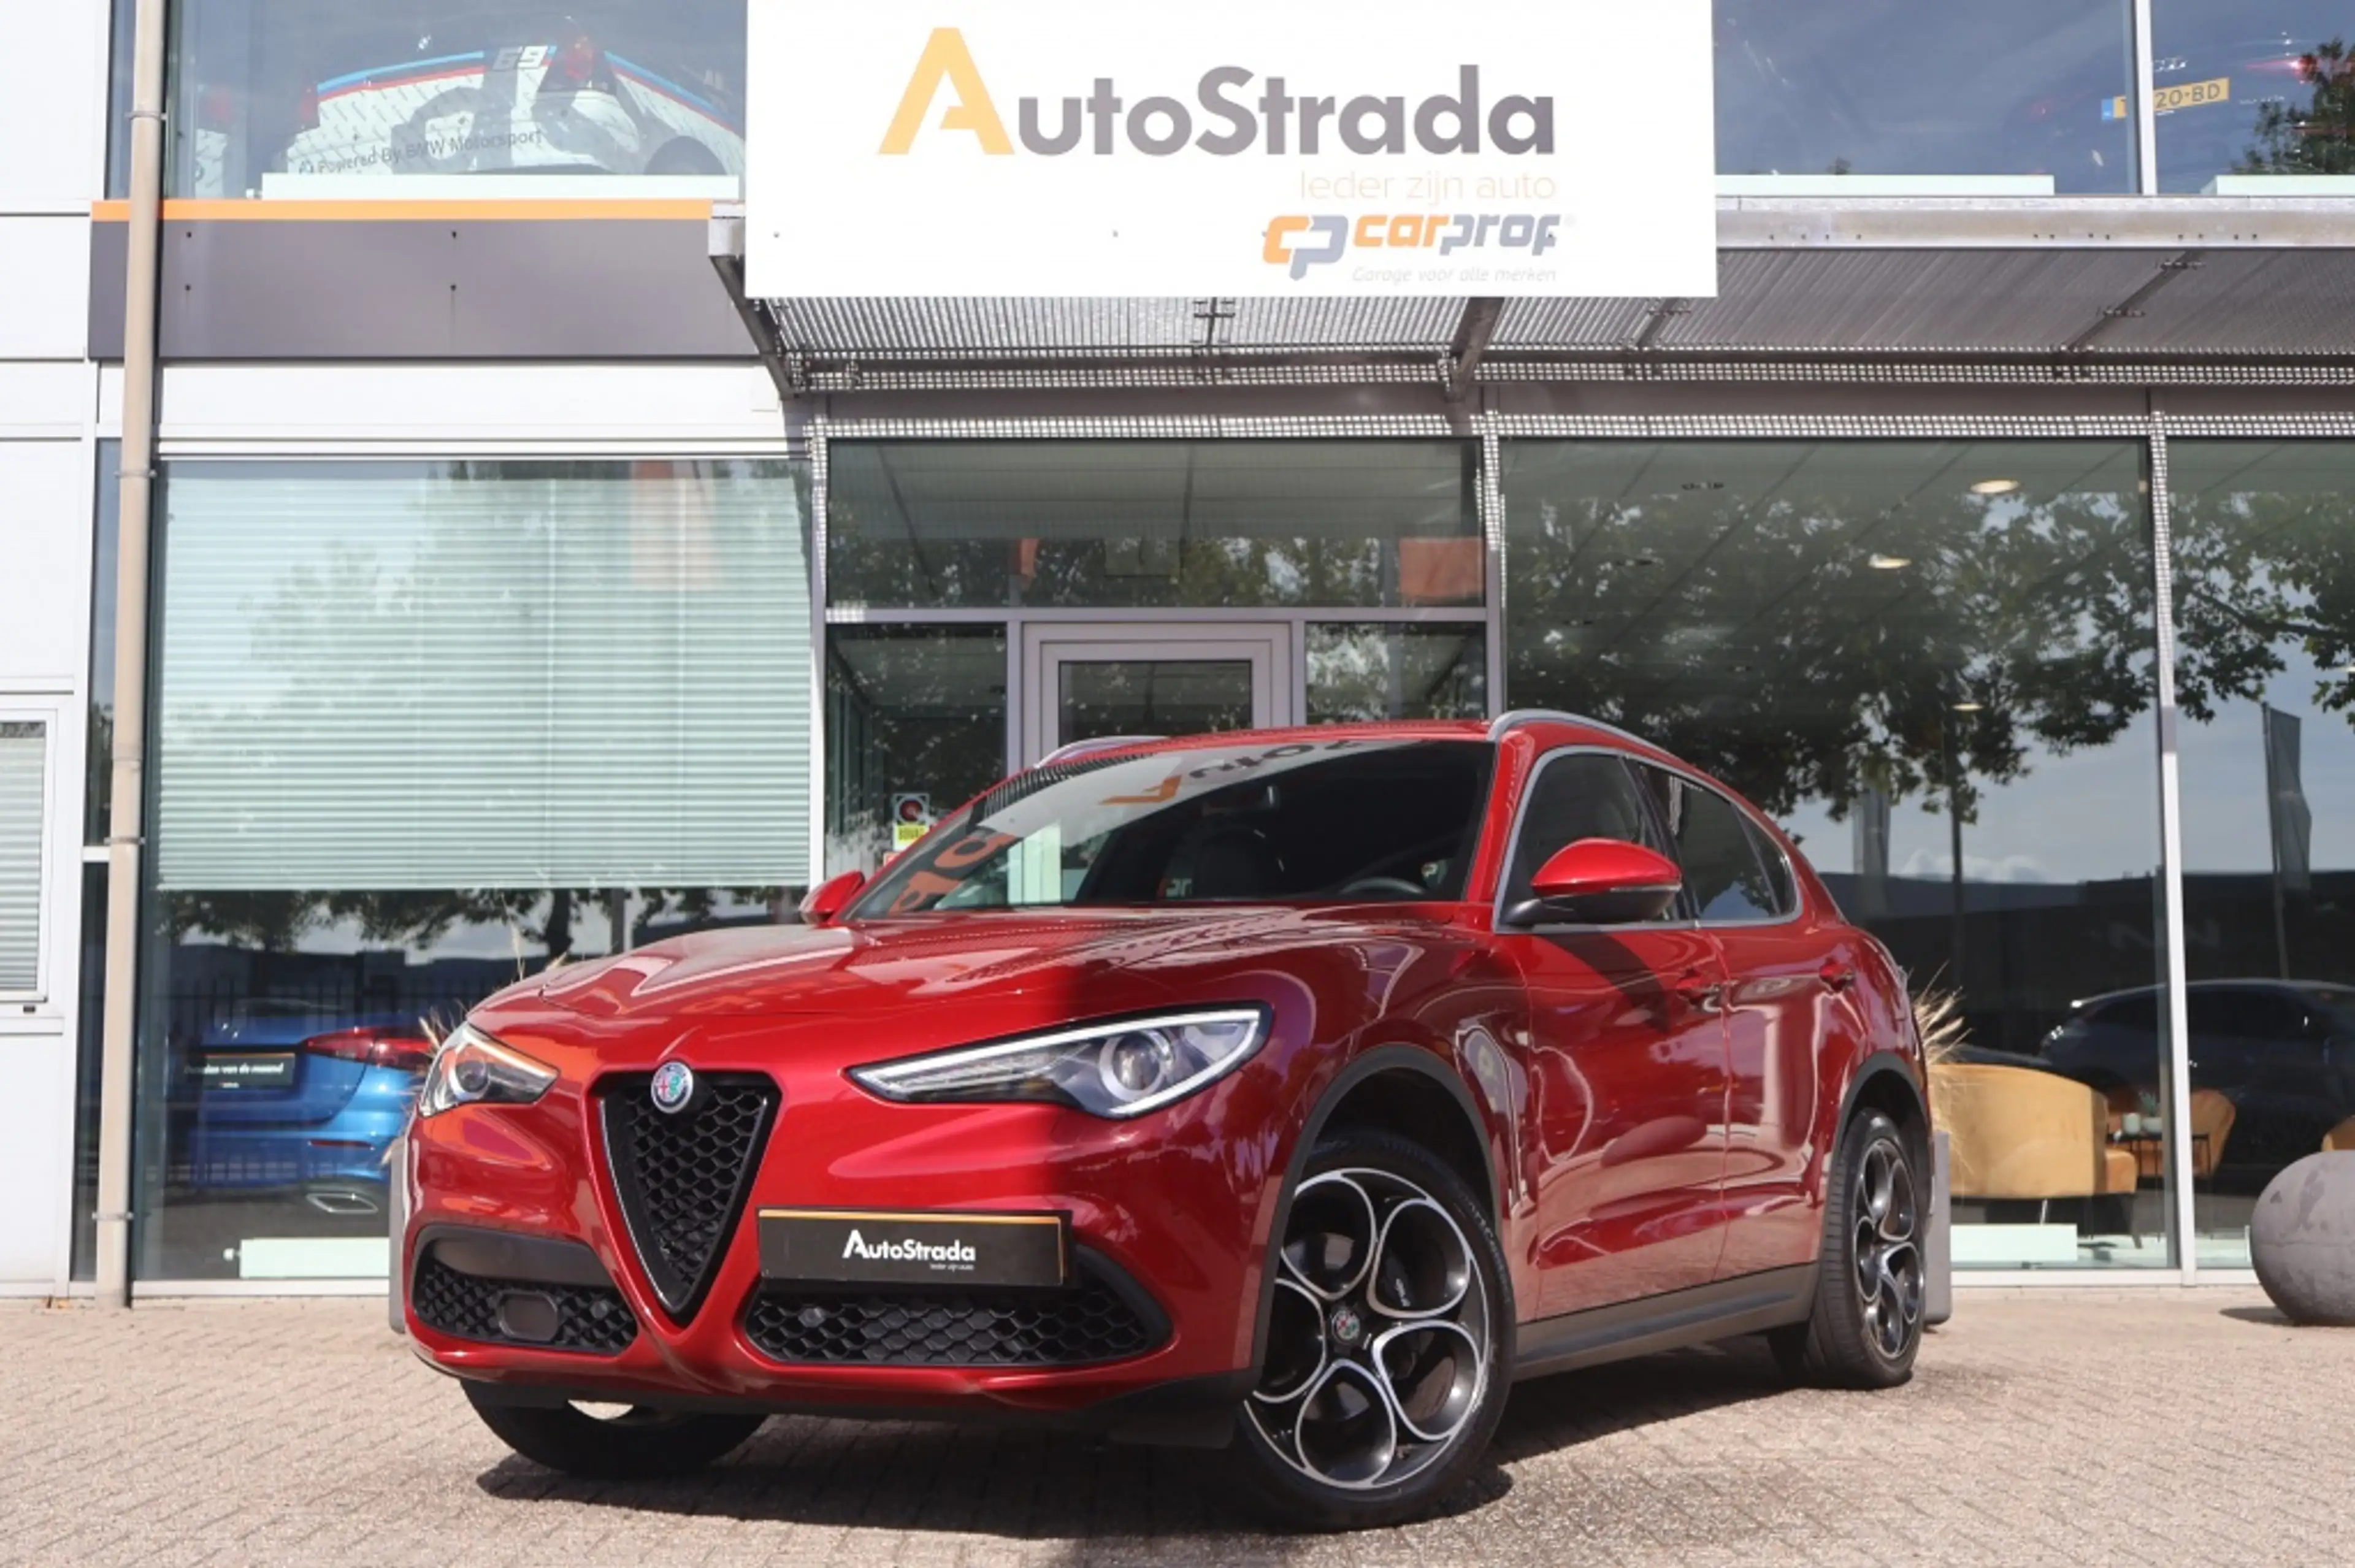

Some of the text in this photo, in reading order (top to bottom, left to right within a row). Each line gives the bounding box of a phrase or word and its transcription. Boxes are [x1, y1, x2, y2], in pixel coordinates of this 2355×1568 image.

[878, 27, 1555, 157] AutoStrada
[1300, 170, 1557, 207] Ieder zijn auto
[1353, 214, 1560, 256] carprof
[1353, 267, 1557, 285] Garage voor alle merken
[842, 1229, 976, 1261] AutoStrada
